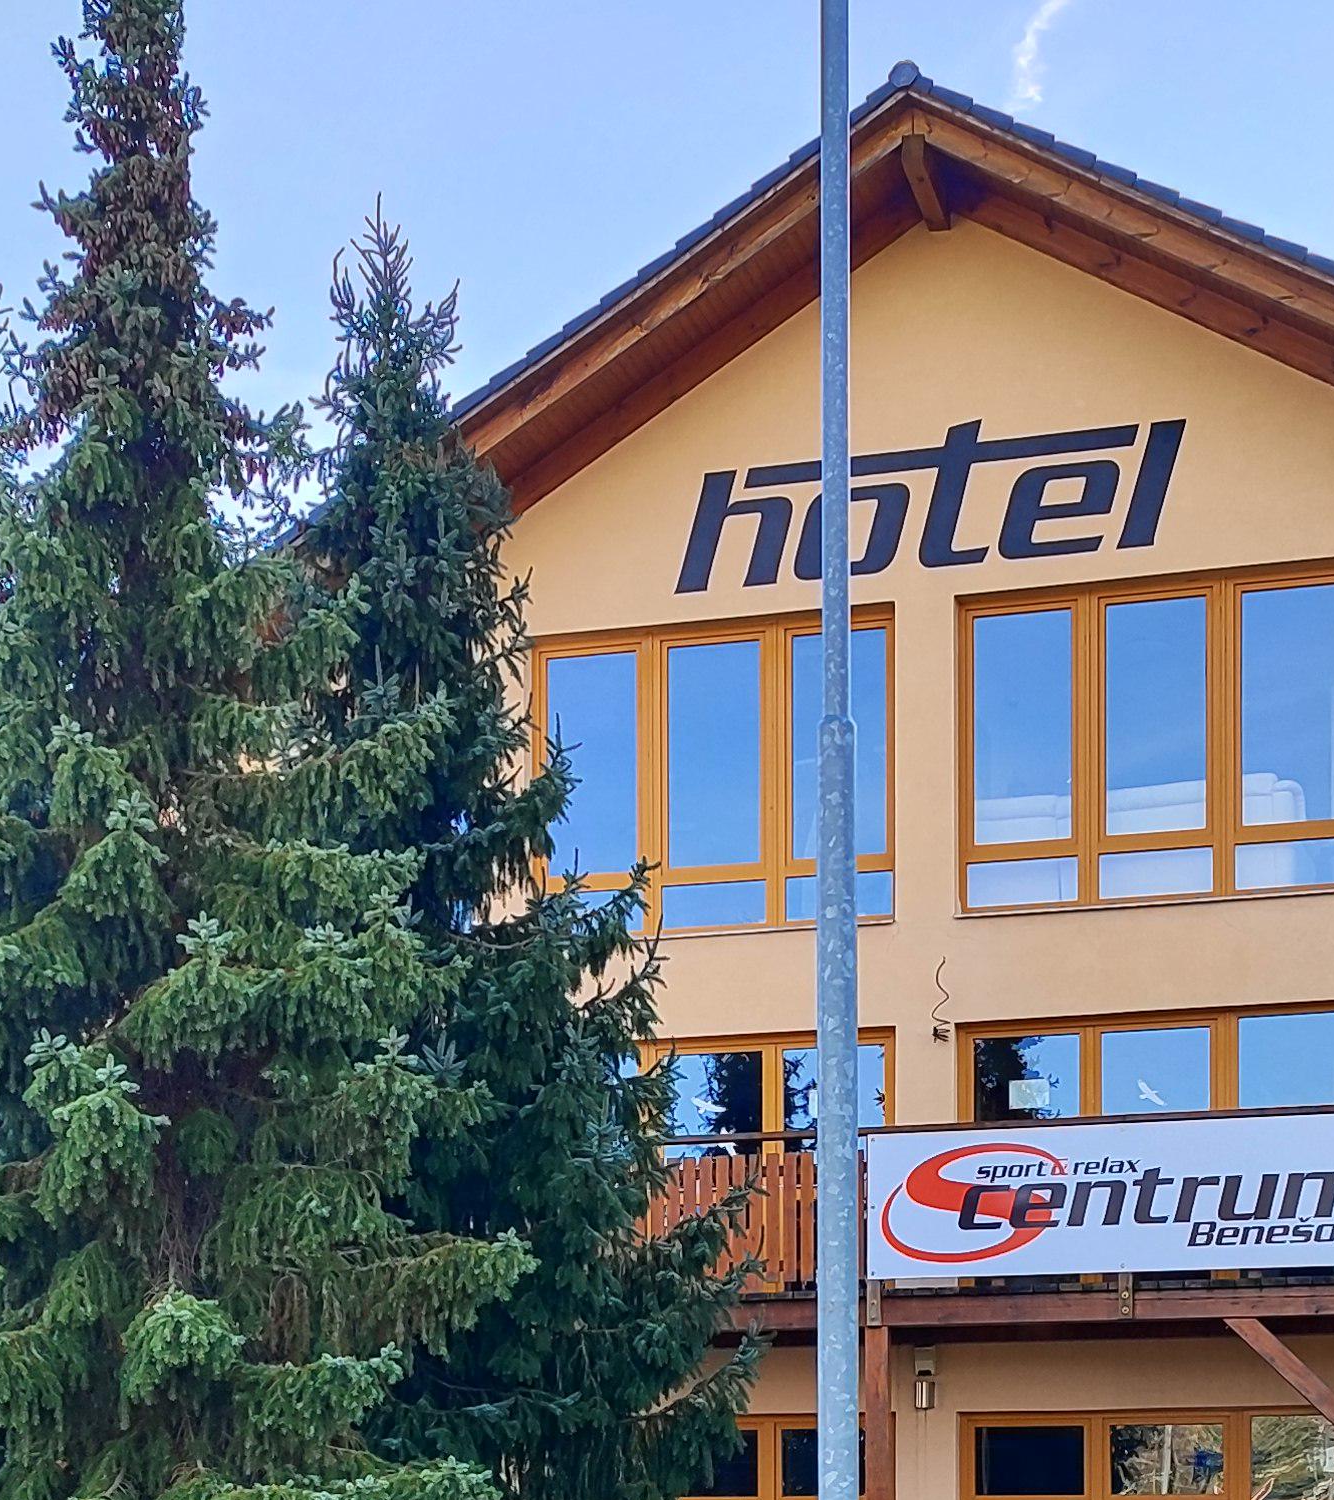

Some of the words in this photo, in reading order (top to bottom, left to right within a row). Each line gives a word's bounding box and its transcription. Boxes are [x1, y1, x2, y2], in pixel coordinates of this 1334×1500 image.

[673, 419, 1187, 595] hotel
[976, 1160, 1048, 1183] sport
[1072, 1156, 1141, 1176] relax
